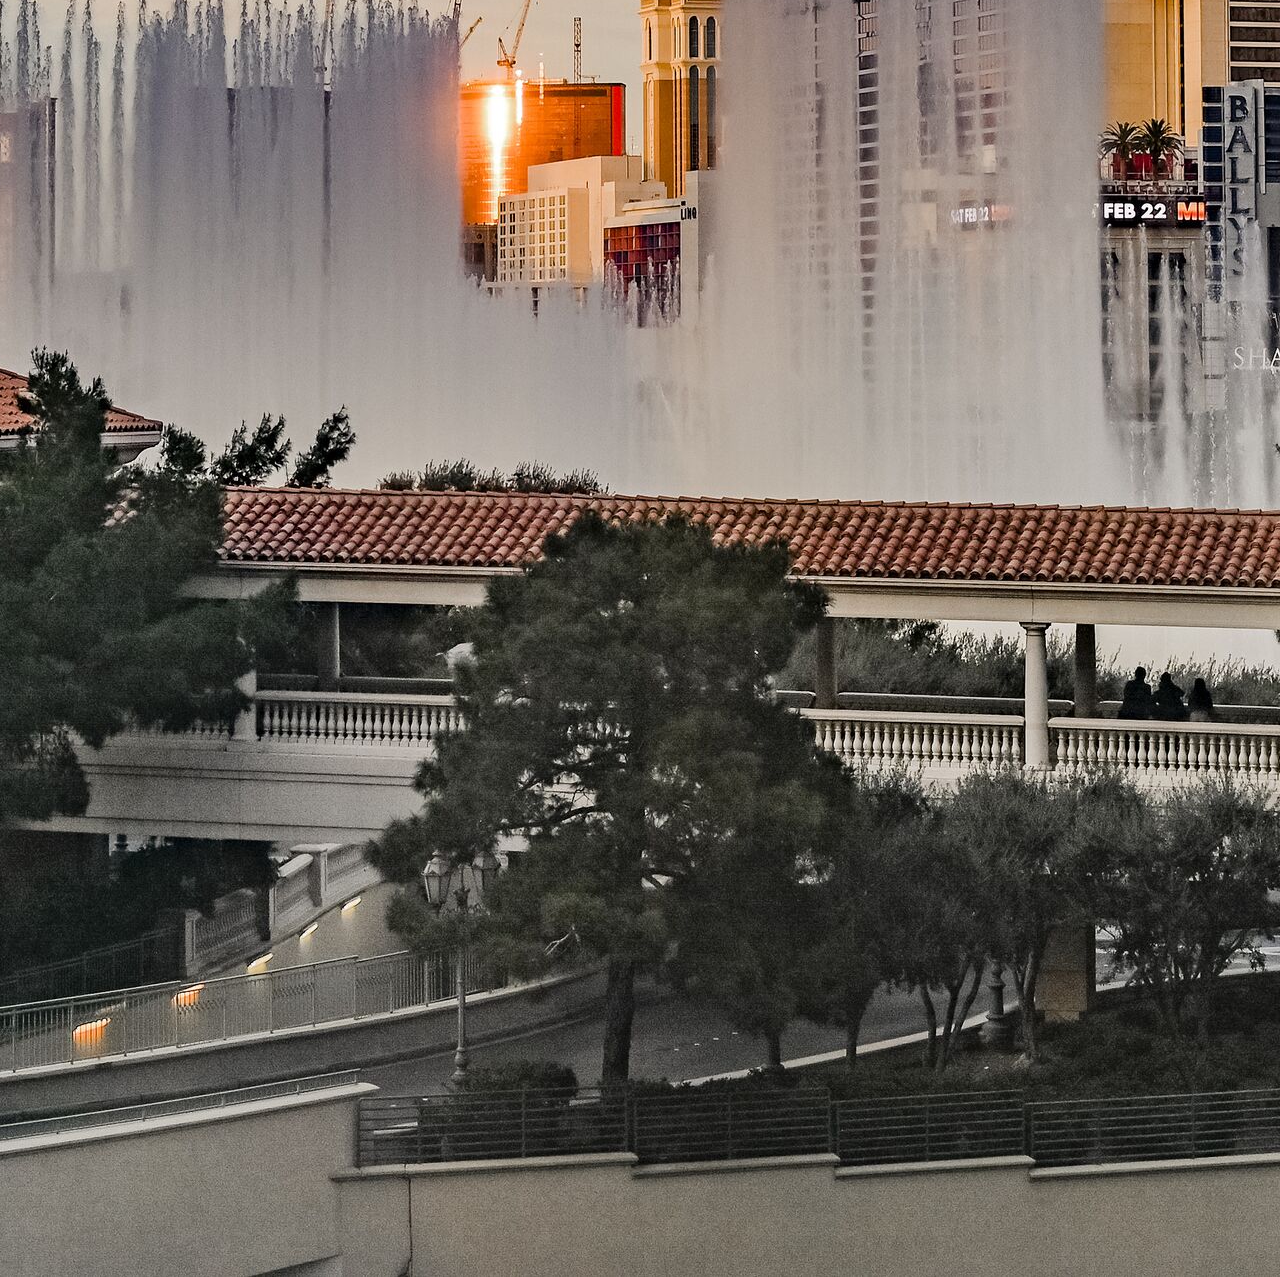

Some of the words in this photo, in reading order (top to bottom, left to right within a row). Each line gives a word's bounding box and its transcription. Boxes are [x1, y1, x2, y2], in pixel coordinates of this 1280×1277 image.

[965, 208, 977, 222] FEB
[1103, 203, 1136, 219] FEB
[1140, 203, 1167, 219] 22
